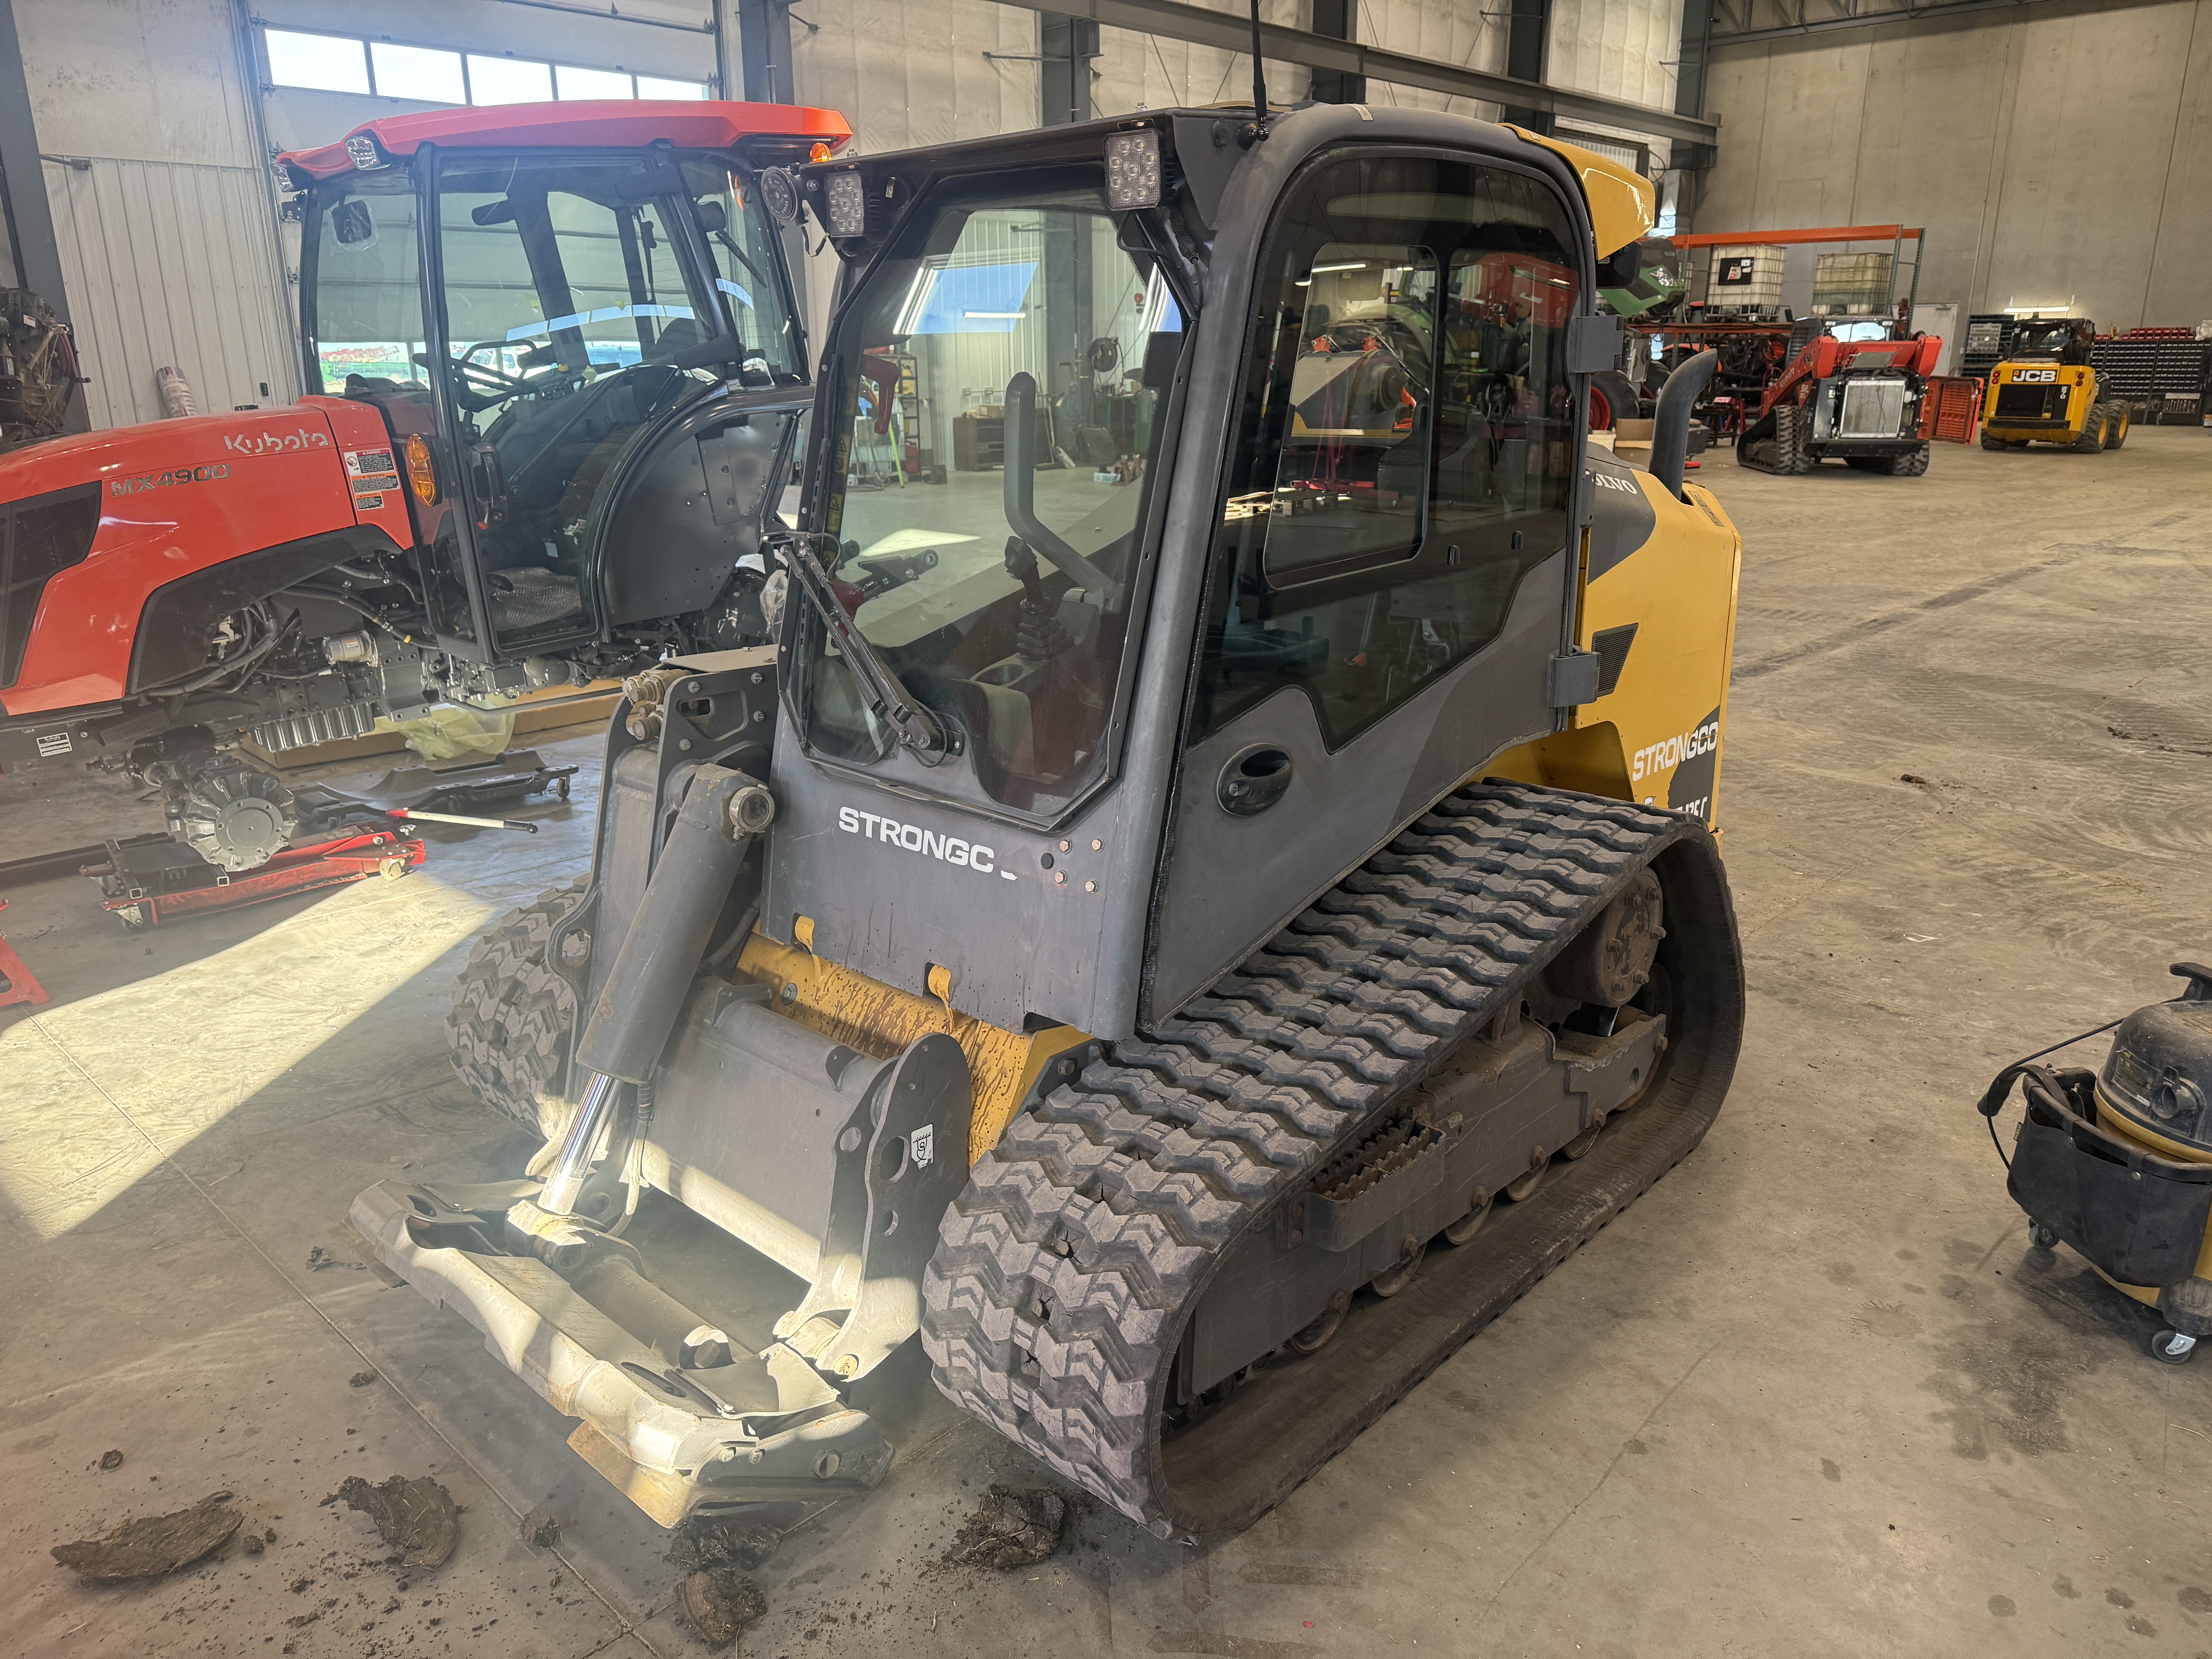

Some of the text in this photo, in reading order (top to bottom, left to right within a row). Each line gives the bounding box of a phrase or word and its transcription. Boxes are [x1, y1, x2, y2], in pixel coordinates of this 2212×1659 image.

[2013, 370, 2056, 382] JCB
[224, 429, 329, 454] Kubota
[112, 464, 230, 497] MX4900
[1585, 471, 1637, 495] OLVO
[1632, 721, 1719, 781] STRONGCO
[839, 807, 1018, 880] STRONGC
